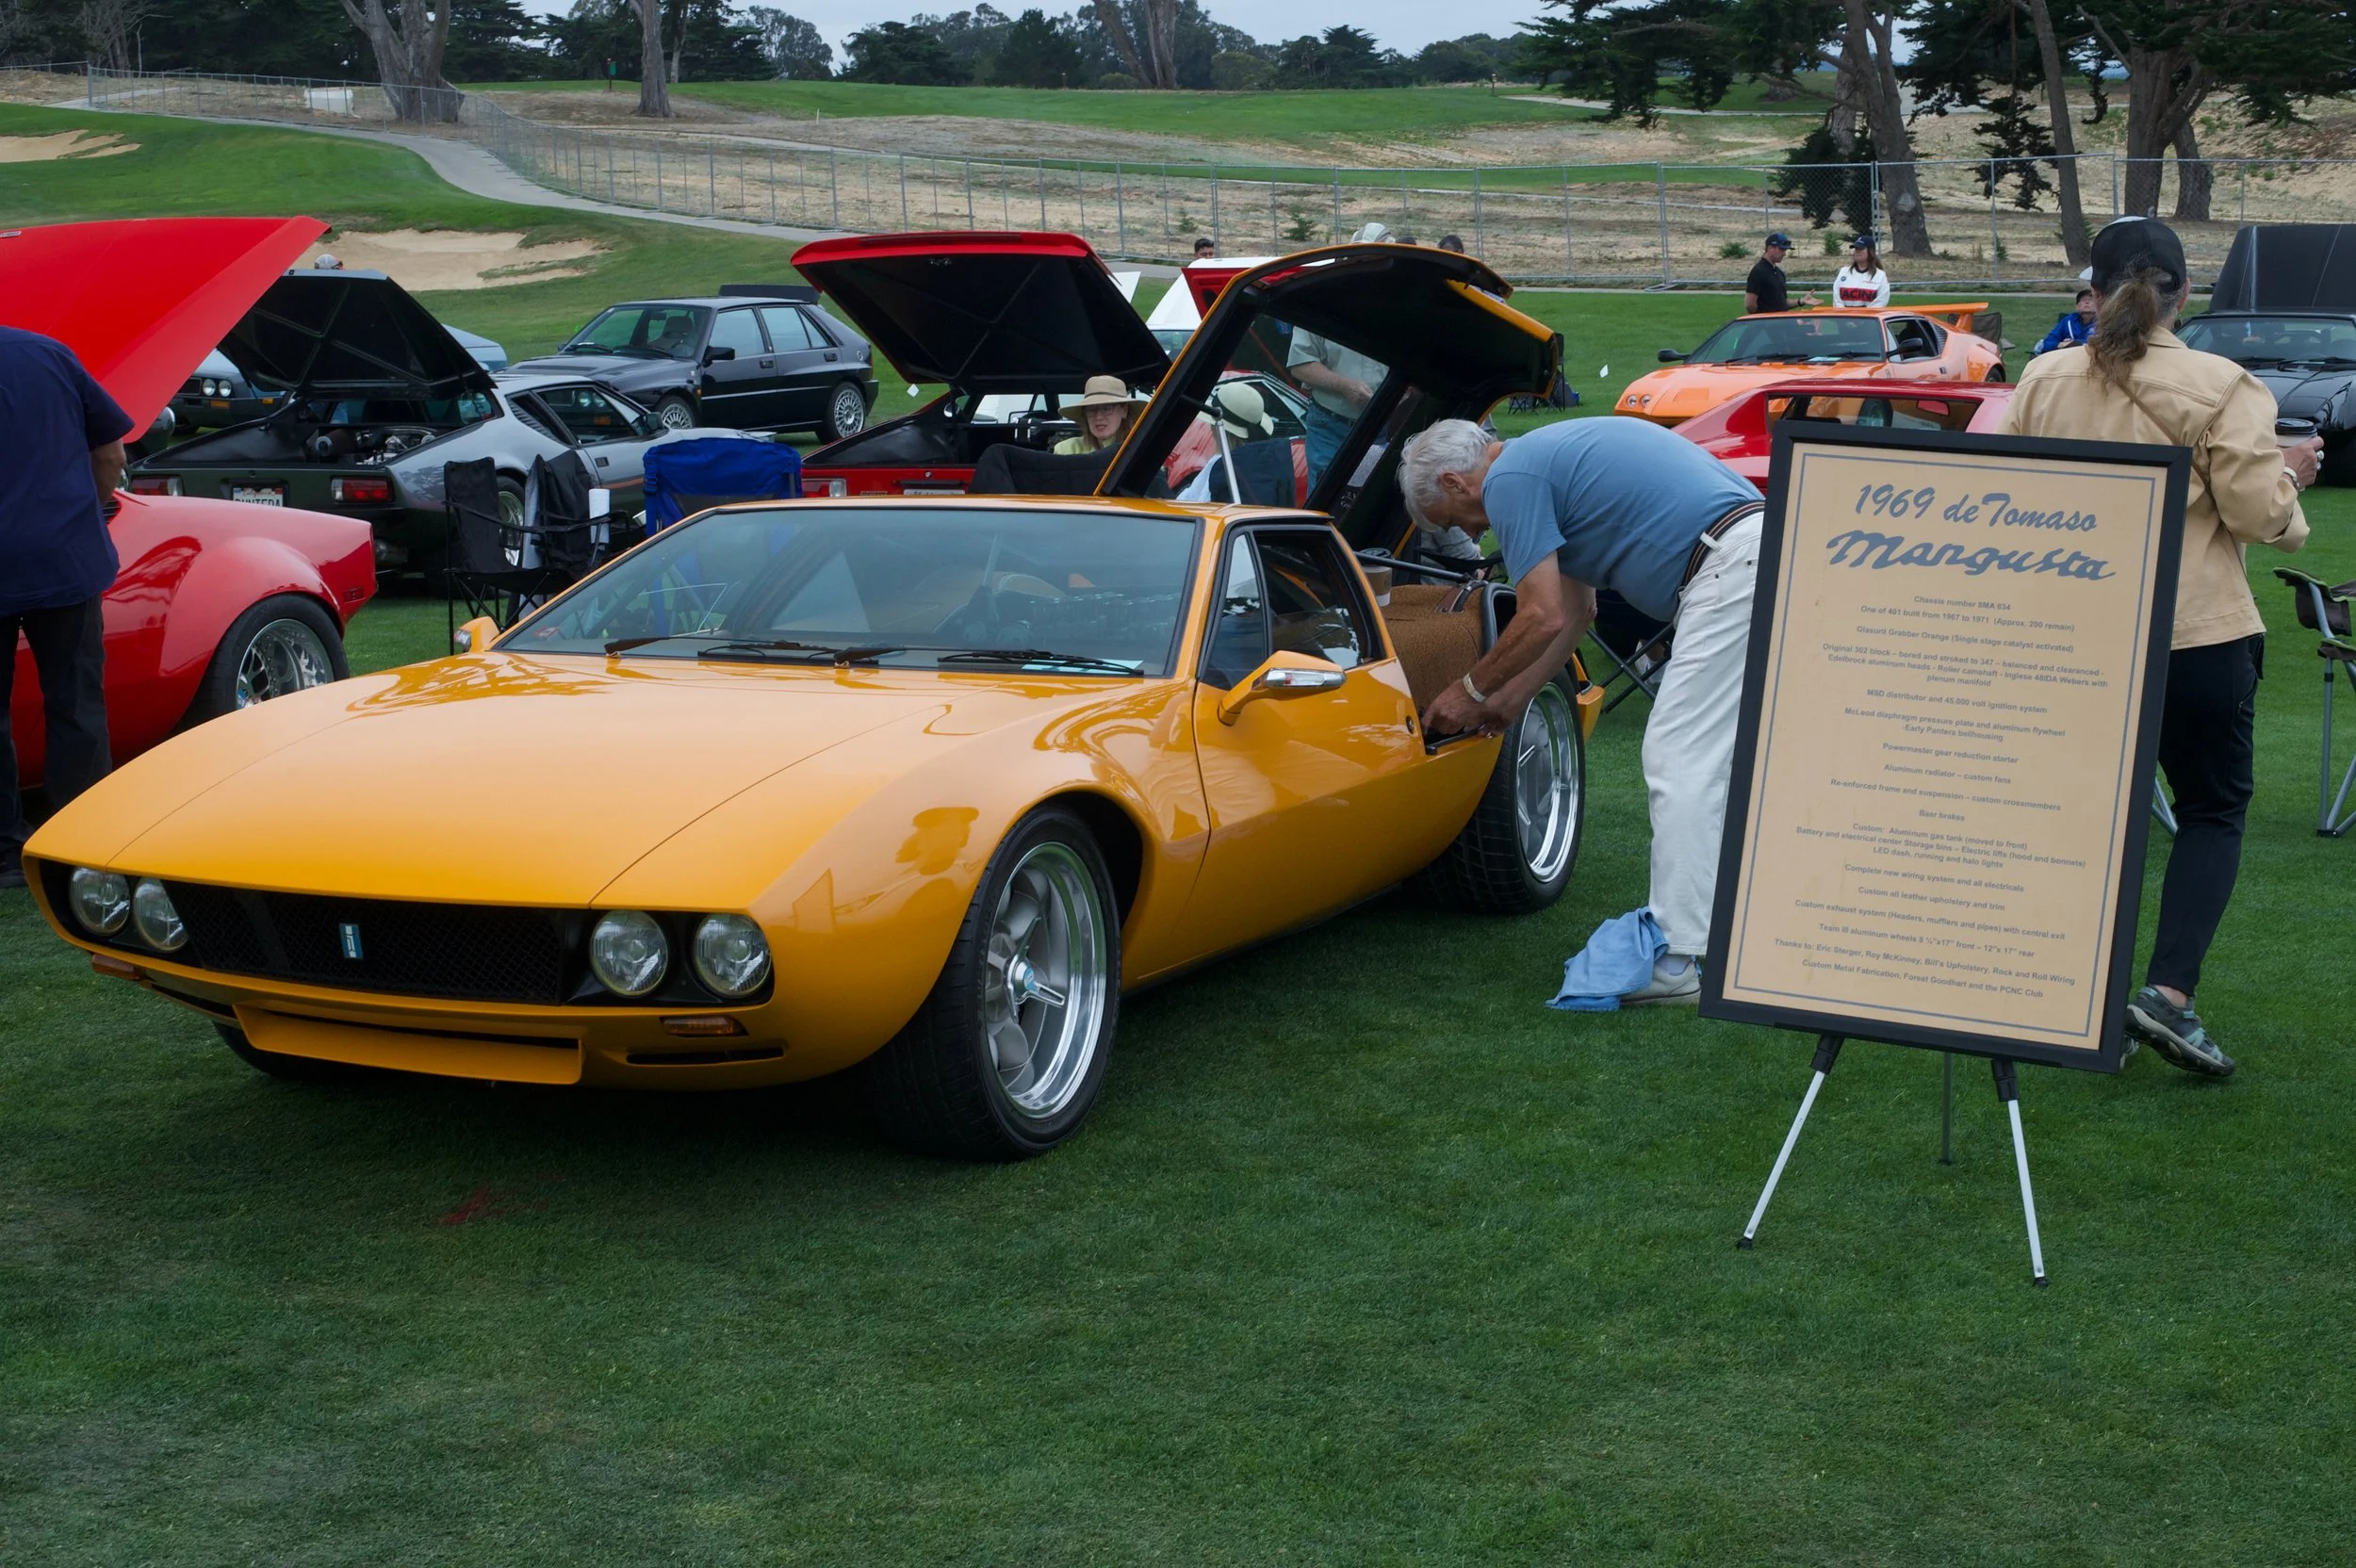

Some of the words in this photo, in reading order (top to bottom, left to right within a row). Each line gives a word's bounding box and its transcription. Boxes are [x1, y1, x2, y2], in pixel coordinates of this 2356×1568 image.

[1856, 483, 1935, 518] 1969
[1825, 530, 2116, 580] Mangusta
[1914, 596, 1944, 604] Chassis
[2044, 623, 2074, 632] remain)
[1889, 629, 1920, 637] Grabber
[1921, 631, 1949, 642] Orange
[1980, 638, 2002, 646] stage
[2035, 644, 2073, 653] activated)
[1823, 643, 1853, 652] Original
[2002, 661, 2037, 670] balanced
[2056, 666, 2100, 676] clearanced
[1828, 653, 1866, 663] Edelbrock
[1868, 659, 1906, 667] aluminum
[1906, 662, 1930, 670] heads
[1937, 664, 1960, 673] Roller
[1962, 668, 1997, 677] camshaft
[2004, 671, 2033, 680] Inglese
[2059, 676, 2088, 685] Webers
[1926, 674, 1955, 682] plenum
[1886, 692, 1926, 701] distributor
[1988, 701, 2017, 710] ignition
[1844, 707, 1875, 716] McLeod
[1876, 711, 1917, 722] diaphragm
[1919, 716, 1953, 725] pressure
[1992, 723, 2031, 733] aluminum
[2032, 727, 2065, 736] flywheel
[1925, 726, 1955, 735] Pantera
[1957, 729, 2004, 742] bellhousing
[1883, 743, 1933, 754] Powermaster
[1954, 751, 1991, 760] reduction
[1991, 755, 2018, 763] starter
[1884, 764, 1922, 774] Aluminum
[1924, 769, 1955, 777] radiator
[1994, 776, 2010, 784] fans
[1878, 784, 1901, 792] frame
[1919, 790, 1963, 799] suspension
[2003, 799, 2060, 810] crossmembers
[1939, 811, 1965, 821] brakes
[1796, 825, 1824, 837] Battery
[1841, 832, 1876, 841] electrical
[1904, 839, 1934, 850] Storage
[1961, 845, 1990, 856] Electric
[1992, 849, 2007, 858] lifts
[2009, 852, 2032, 860] (hood
[2050, 857, 2086, 868] bonnets)
[1889, 827, 1928, 837] Aluminum
[1965, 837, 1994, 845] (moved
[2005, 841, 2027, 851] front)
[1914, 852, 1944, 862] running
[1962, 857, 1979, 865] halo
[1981, 859, 2003, 868] lights
[1844, 864, 1881, 874] Complete
[1901, 872, 1924, 881] wiring
[1984, 882, 2023, 891] electricals
[1858, 886, 1888, 896] Custom
[1901, 891, 1927, 901] leather
[1929, 896, 1971, 907] upholstery
[1795, 899, 1824, 909] Custom
[1825, 905, 1857, 913] exhaust
[1858, 908, 1886, 917] system
[1926, 917, 1958, 926] mufflers
[1976, 923, 2001, 933] pipes)
[2021, 929, 2049, 938] central
[1819, 923, 1840, 932] Team
[1850, 928, 1888, 938] aluminum
[1955, 940, 1974, 949] front
[1775, 938, 1802, 948] Thanks
[1865, 950, 1881, 960] Roy
[1992, 967, 2012, 975] Rock
[2031, 972, 2047, 980] Roll
[2050, 974, 2075, 986] Wiring
[1802, 958, 1832, 970] Custom
[1833, 963, 1854, 972] Metal
[1904, 972, 1928, 982] Forest
[2024, 988, 2043, 997] Club
